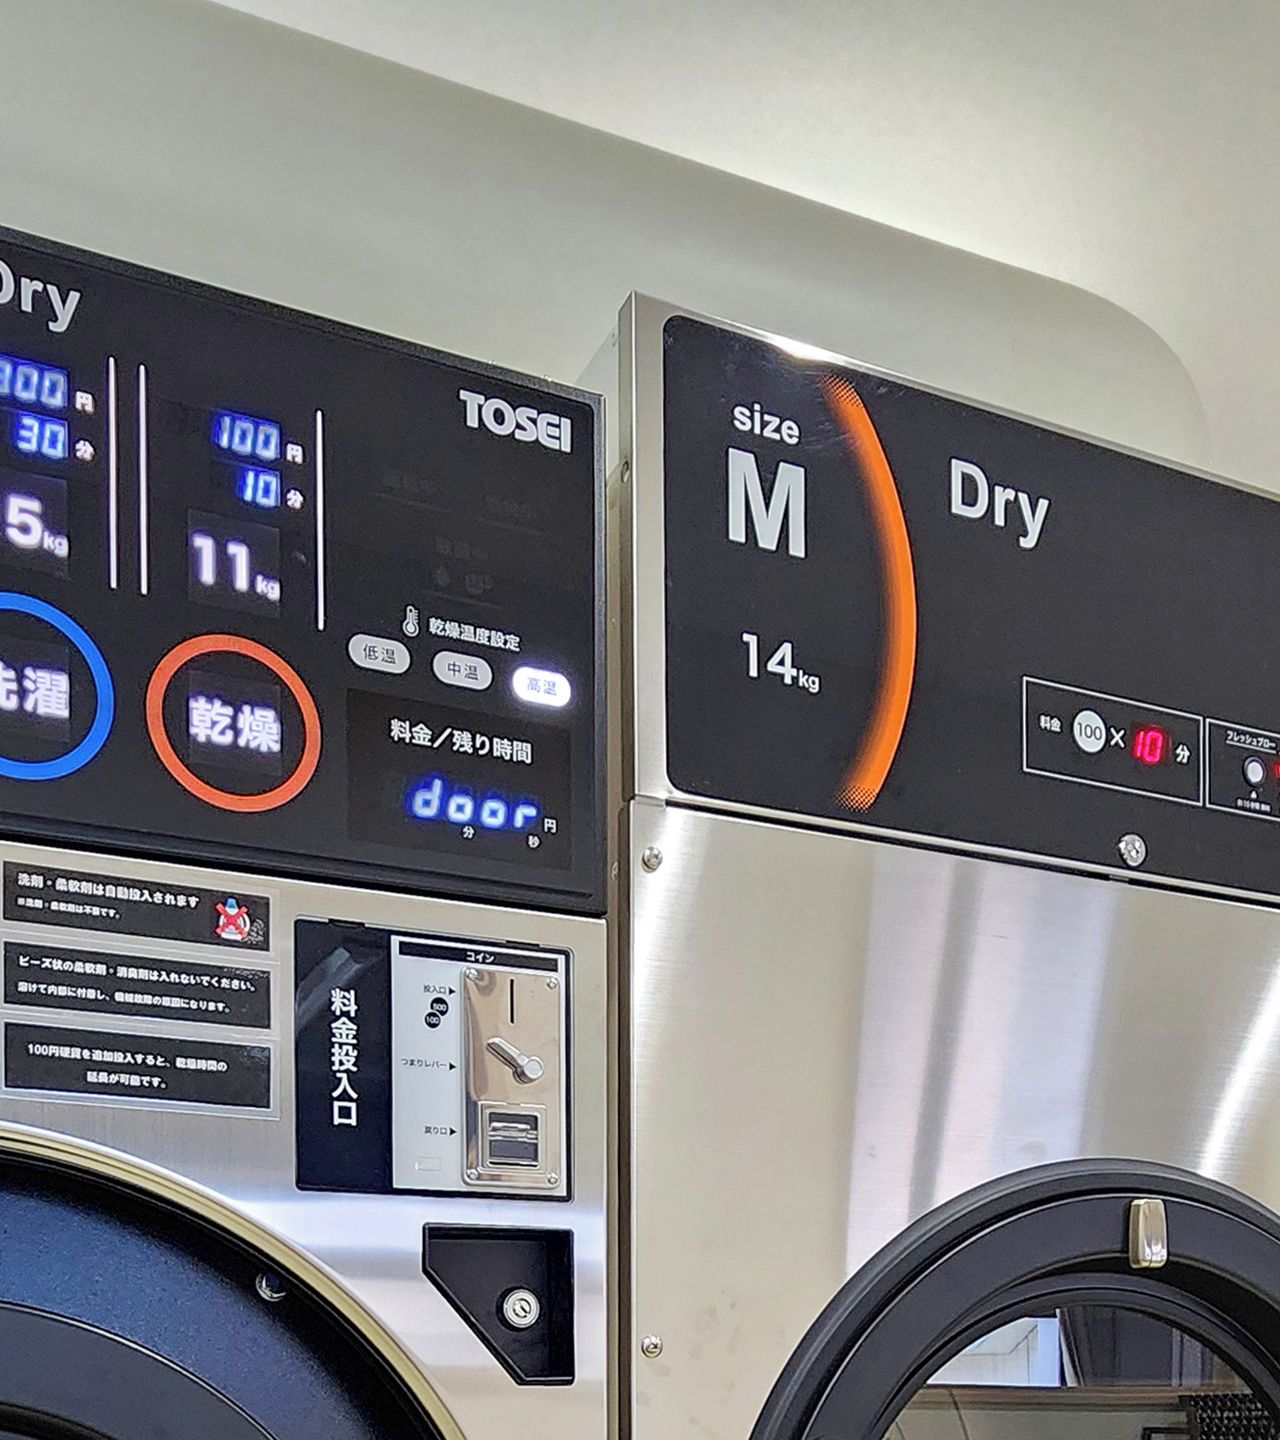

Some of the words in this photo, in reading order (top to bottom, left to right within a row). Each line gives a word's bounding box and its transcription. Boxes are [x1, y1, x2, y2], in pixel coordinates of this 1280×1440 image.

[75, 389, 95, 414] 円
[458, 388, 573, 454] TOSEI
[17, 415, 69, 461] 30
[75, 438, 96, 462] 分
[217, 410, 281, 462] 100
[286, 442, 304, 465] 円
[732, 402, 801, 446] size
[241, 468, 281, 508] 10
[286, 487, 305, 511] 分
[727, 446, 807, 559] M
[950, 457, 1050, 549] Dry
[363, 643, 397, 665] 低温
[429, 616, 521, 652] 乾燥温度設定
[447, 661, 480, 682] 中温
[526, 675, 558, 697] 高温
[188, 696, 282, 754] 乾燥
[1039, 714, 1062, 733] 料金
[1076, 721, 1103, 742] 100
[1135, 729, 1164, 764] 10
[1175, 743, 1191, 764] 分
[412, 777, 538, 829] door
[543, 817, 558, 834] 円
[463, 825, 476, 839] 分
[528, 835, 540, 849] 秒
[466, 951, 496, 964] コイン
[423, 984, 447, 996] 投入口
[330, 987, 359, 1128] 料金投入口
